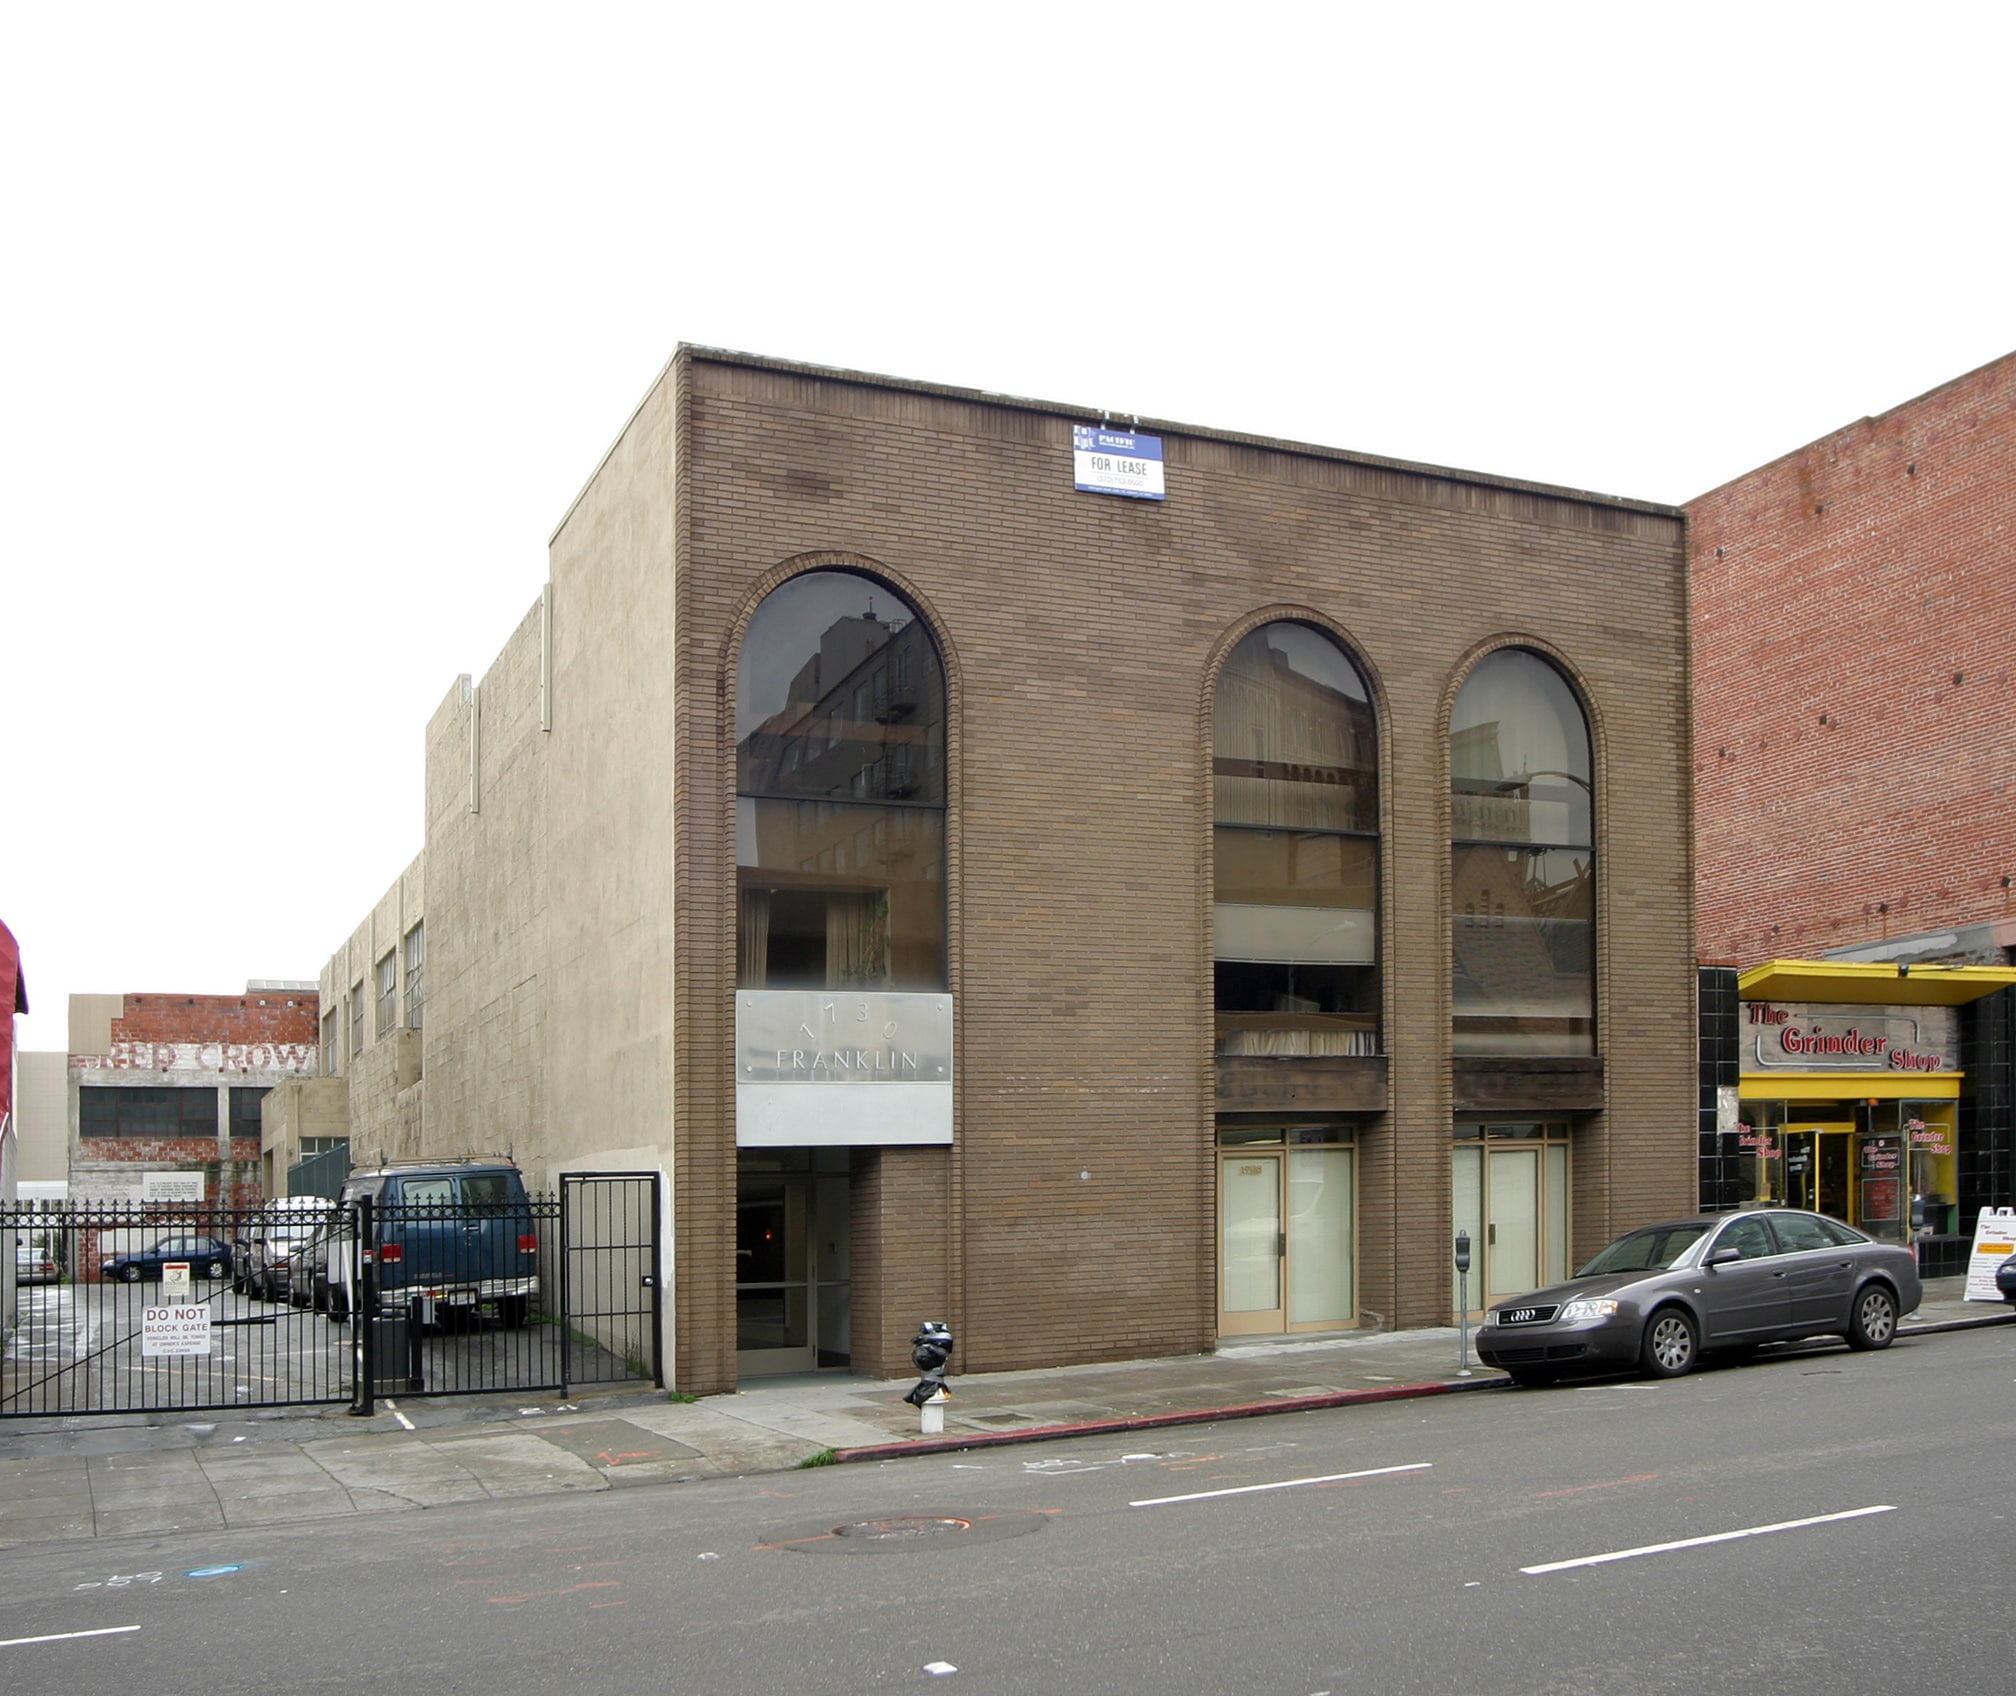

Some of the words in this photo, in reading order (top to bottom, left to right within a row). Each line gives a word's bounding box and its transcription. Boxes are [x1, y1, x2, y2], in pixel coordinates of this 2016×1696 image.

[1091, 456, 1111, 471] FOR
[1117, 459, 1147, 476] LEASE
[1748, 1002, 1789, 1024] The
[1782, 1026, 1888, 1055] Grinder
[110, 1043, 177, 1070] RED
[776, 1049, 918, 1070] FRANKLIN
[1890, 1048, 1942, 1072] Shop
[1756, 1147, 1784, 1159] Shop
[147, 1309, 169, 1321] DO
[175, 1308, 206, 1320] NOT
[145, 1324, 178, 1333] BLOCK
[182, 1323, 208, 1332] GATE
